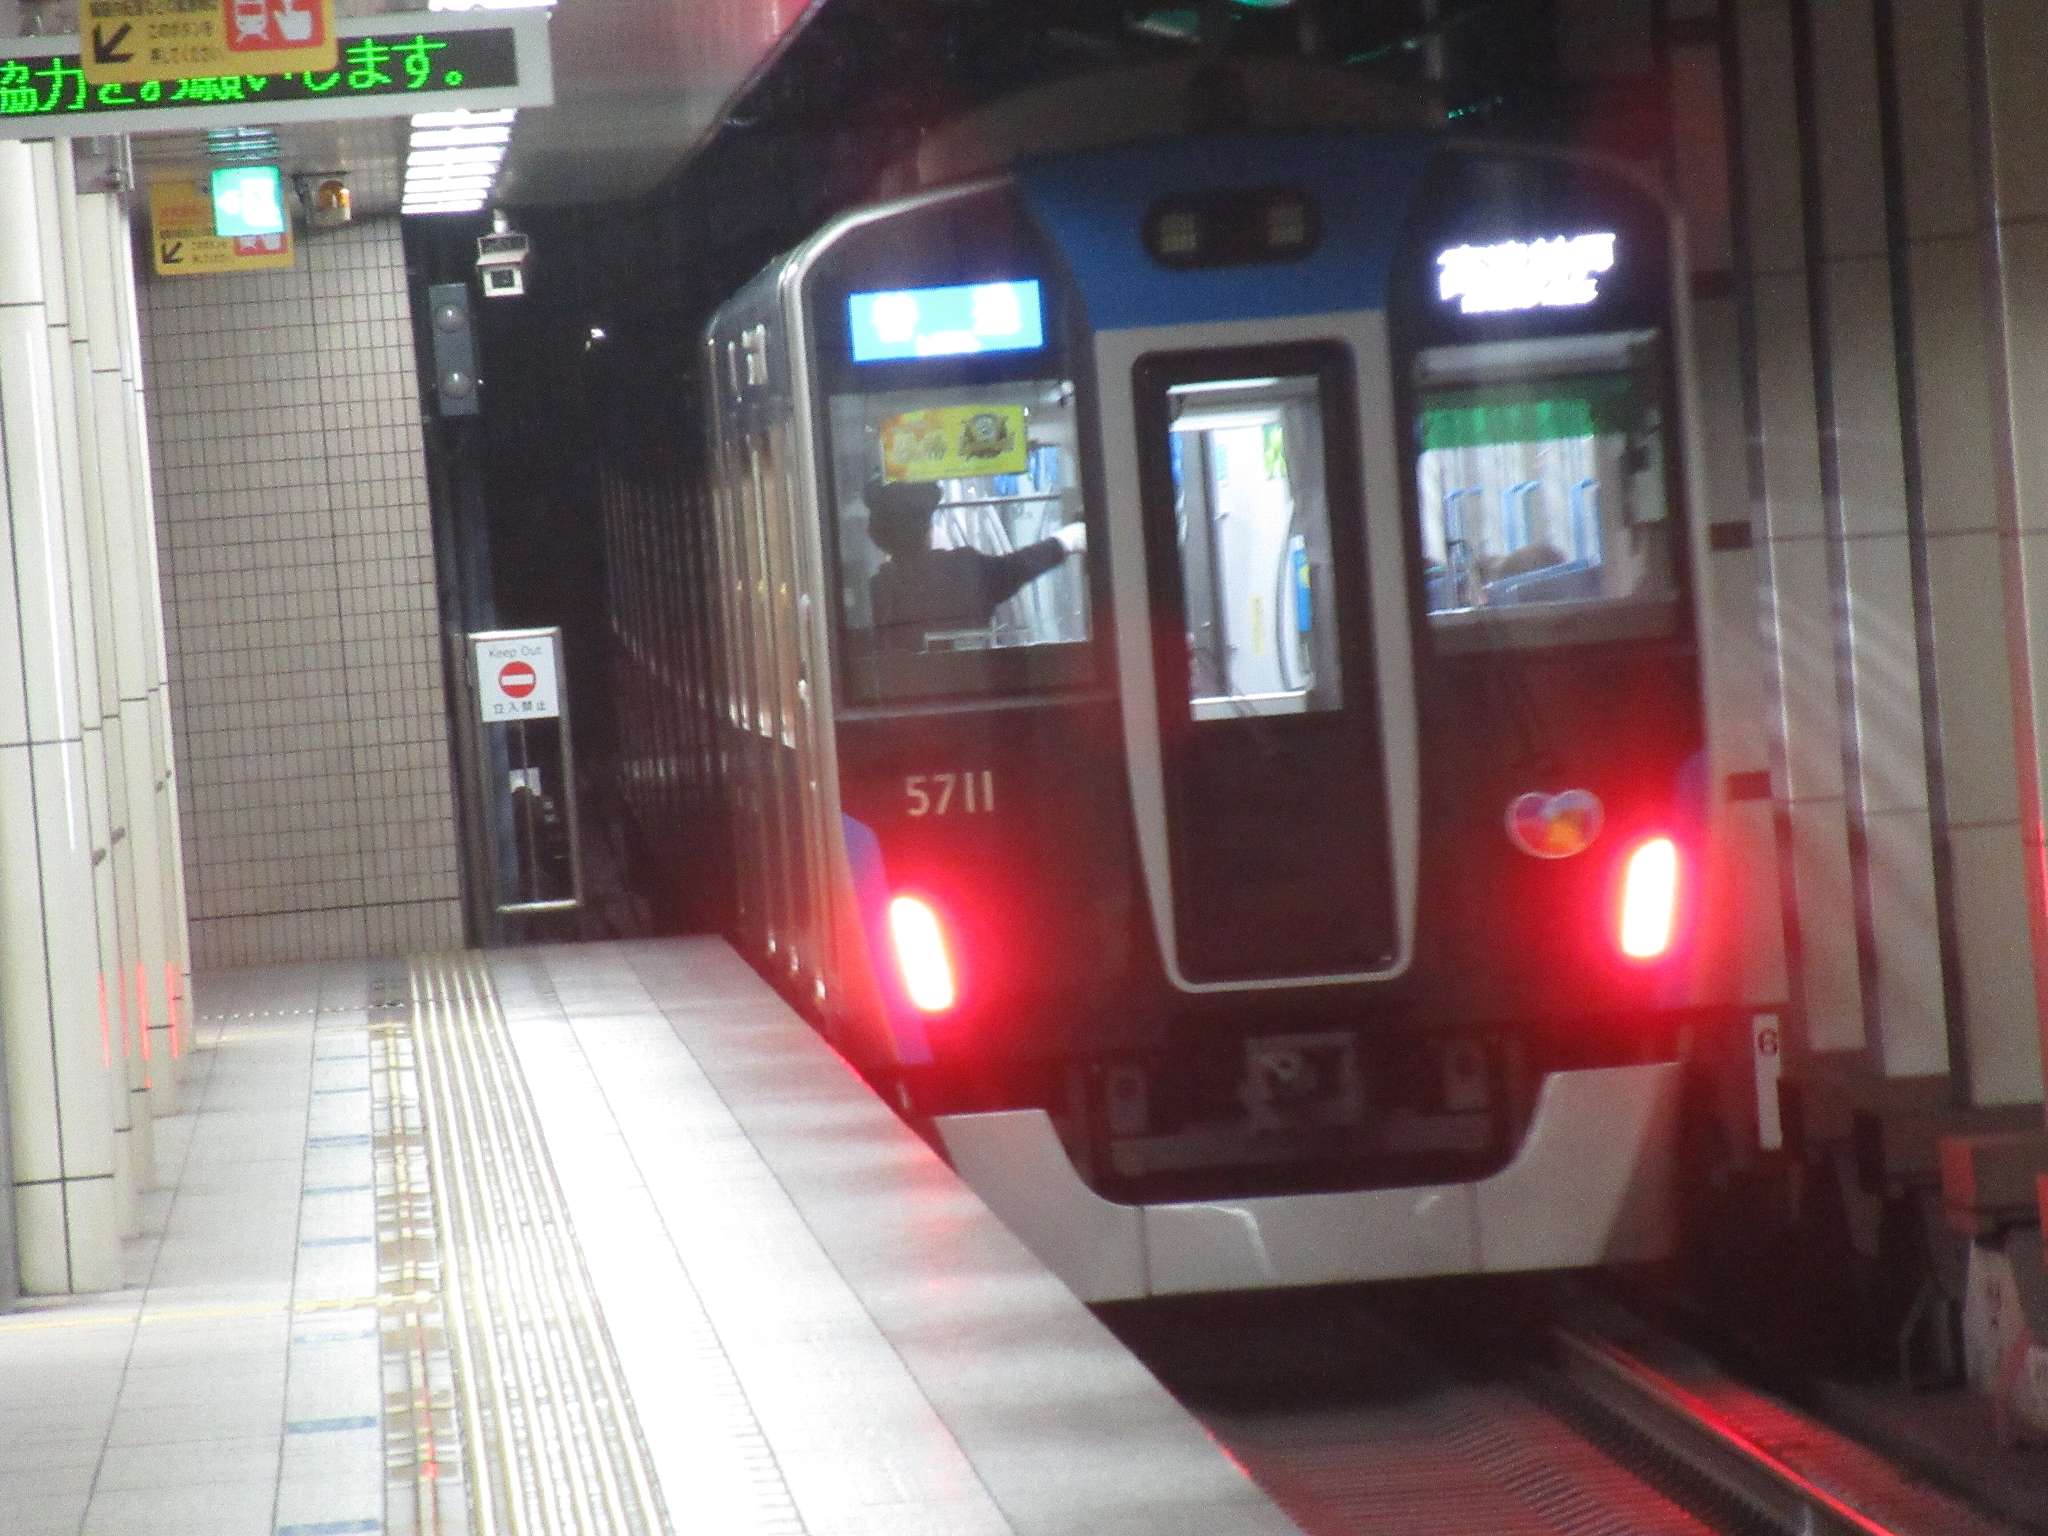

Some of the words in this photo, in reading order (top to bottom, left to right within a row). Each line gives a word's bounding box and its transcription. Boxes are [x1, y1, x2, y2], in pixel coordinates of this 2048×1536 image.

[489, 648, 516, 658] Keep
[521, 646, 542, 656] Out
[905, 771, 994, 817] 5711
